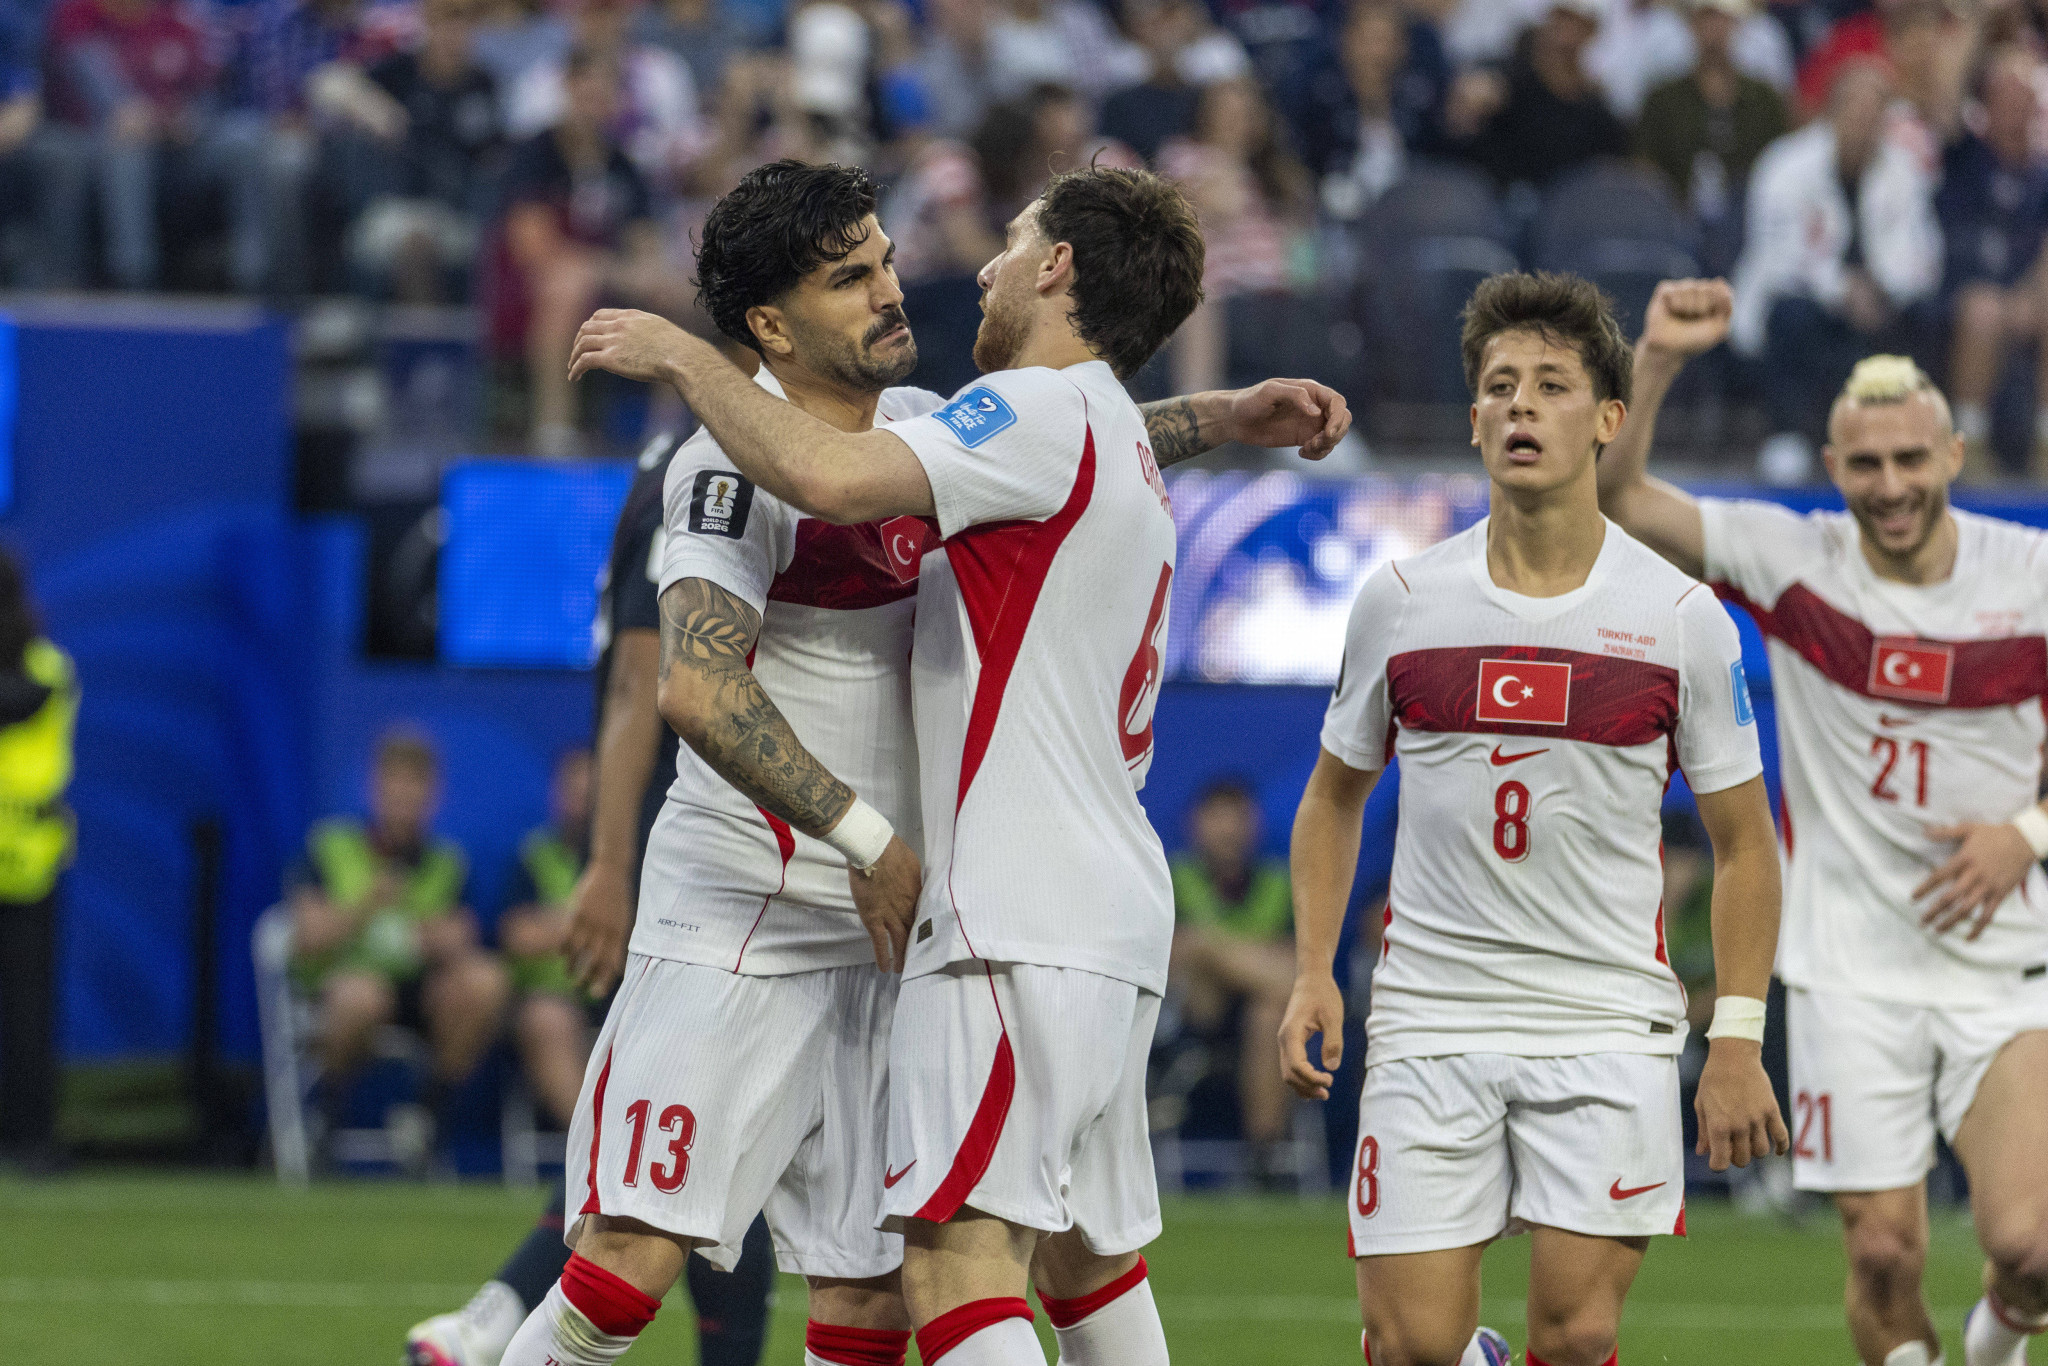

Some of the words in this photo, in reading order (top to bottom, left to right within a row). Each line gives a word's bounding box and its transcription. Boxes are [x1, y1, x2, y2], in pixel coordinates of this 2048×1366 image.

[952, 409, 977, 430] PEACE
[701, 523, 728, 532] 2026
[1870, 735, 1930, 808] 21
[1494, 780, 1532, 864] 8
[657, 917, 702, 933] AERO-FIT
[623, 1099, 697, 1195] 13
[1794, 1090, 1832, 1162] 21
[1356, 1135, 1381, 1220] 8
